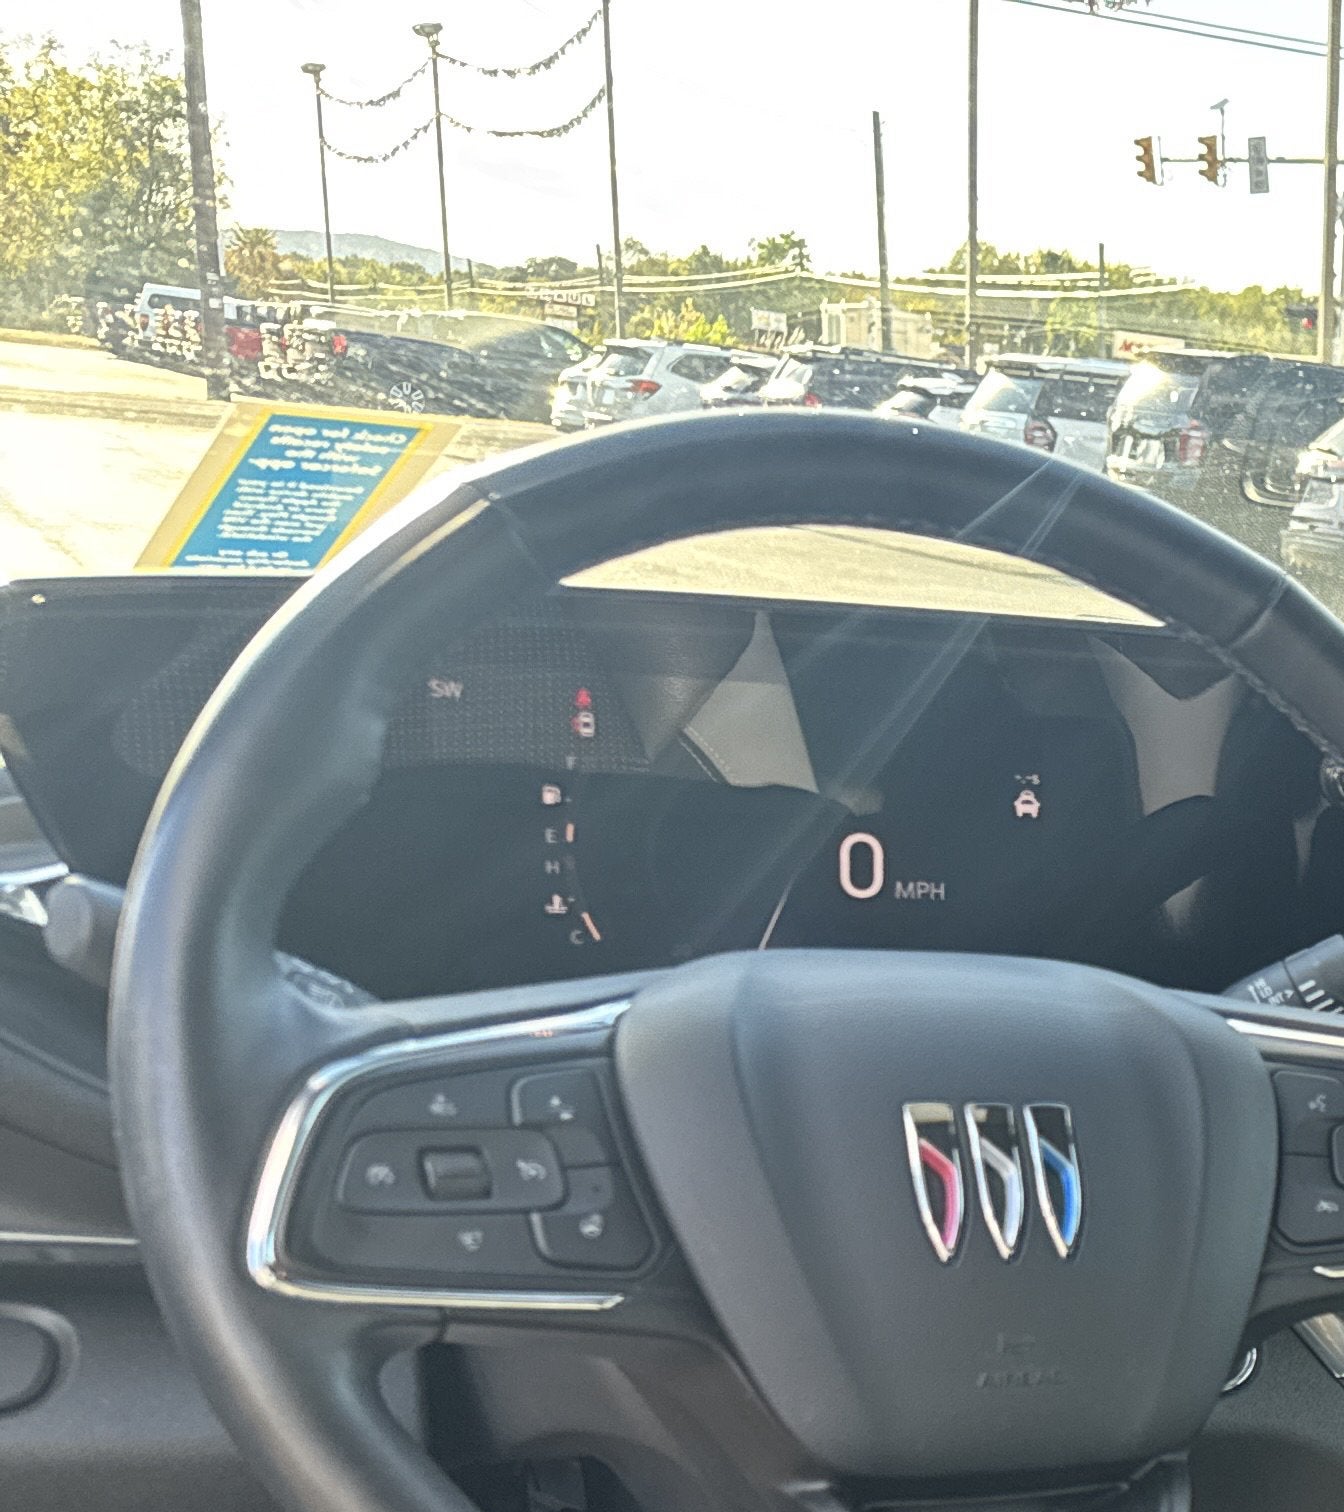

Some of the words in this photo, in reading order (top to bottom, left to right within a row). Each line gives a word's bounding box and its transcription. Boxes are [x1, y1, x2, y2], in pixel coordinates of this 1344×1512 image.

[427, 676, 464, 700] SW
[839, 832, 884, 899] 0
[894, 880, 946, 901] MPH
